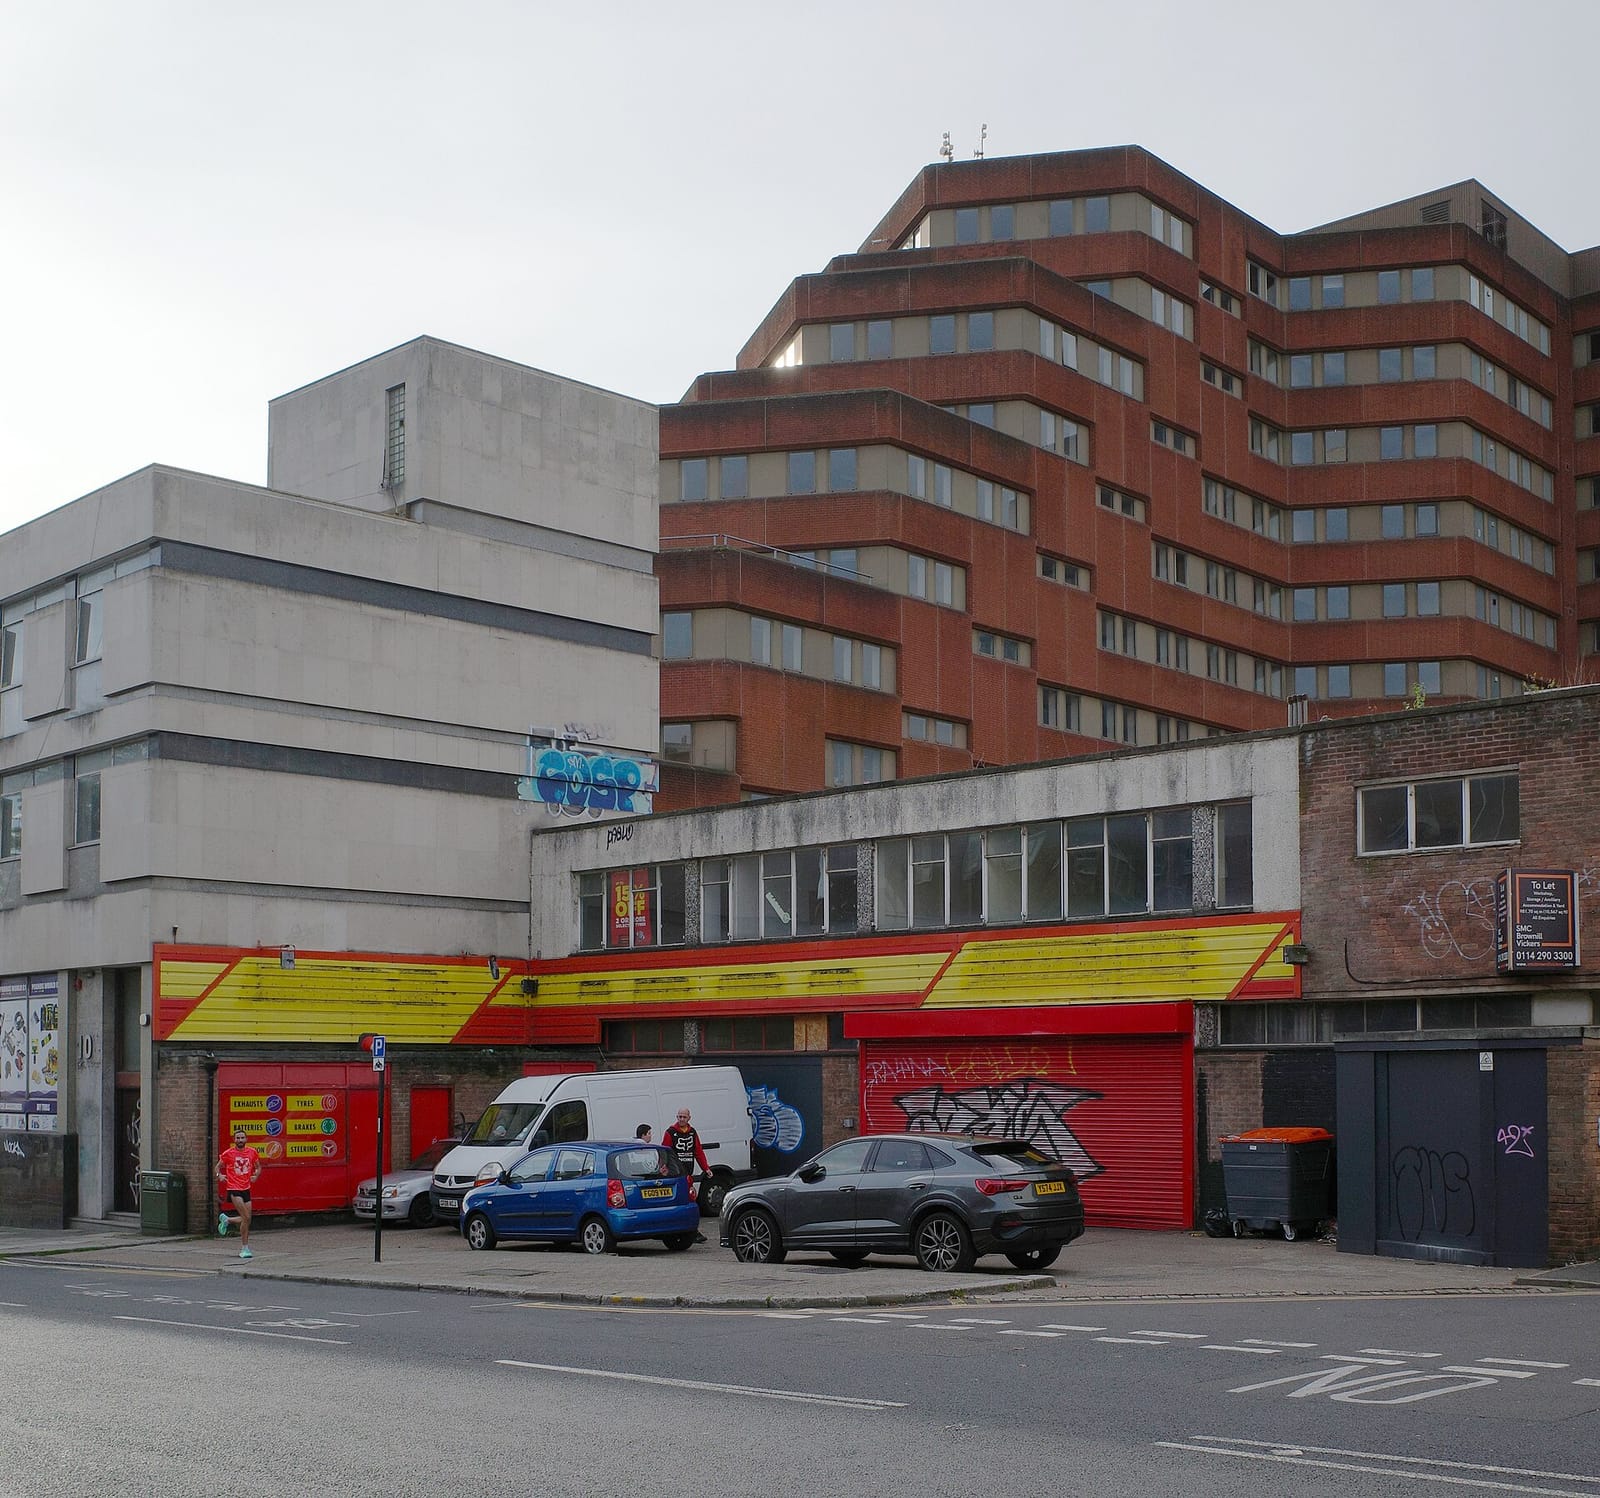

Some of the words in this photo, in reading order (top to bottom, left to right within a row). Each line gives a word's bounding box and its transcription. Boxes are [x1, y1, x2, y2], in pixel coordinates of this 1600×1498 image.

[1531, 881, 1540, 890] To
[1543, 881, 1556, 890] Let
[1516, 952, 1535, 960] 0114
[1536, 952, 1552, 960] 290
[1554, 952, 1573, 960] 3300
[80, 1034, 93, 1060] 10
[375, 1039, 382, 1056] P
[1226, 1365, 1498, 1404] NO
